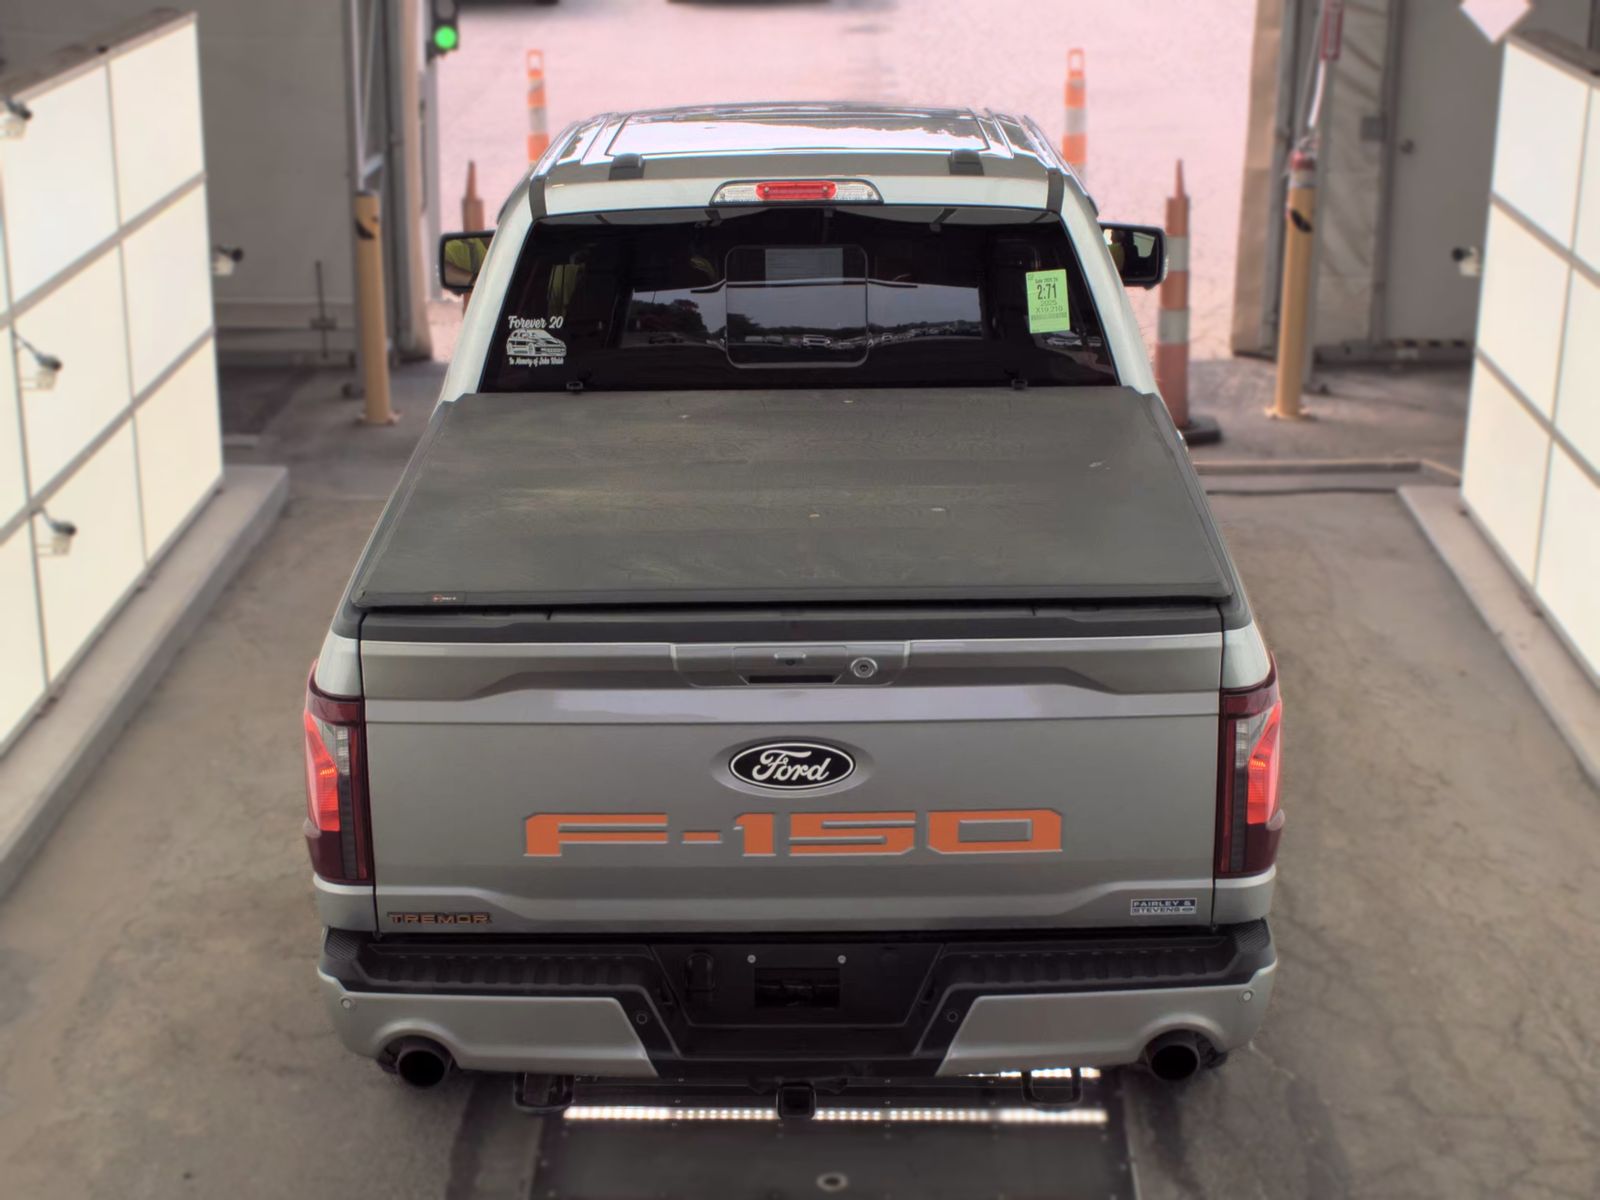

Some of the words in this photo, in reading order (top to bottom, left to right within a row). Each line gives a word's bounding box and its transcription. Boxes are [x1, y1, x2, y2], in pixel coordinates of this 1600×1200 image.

[1037, 284, 1056, 300] 2:71
[508, 315, 547, 329] Forever
[548, 316, 564, 328] 20
[533, 357, 538, 368] of
[752, 748, 831, 785] Ford
[523, 809, 1064, 857] F-150
[387, 911, 492, 925] TREMOR
